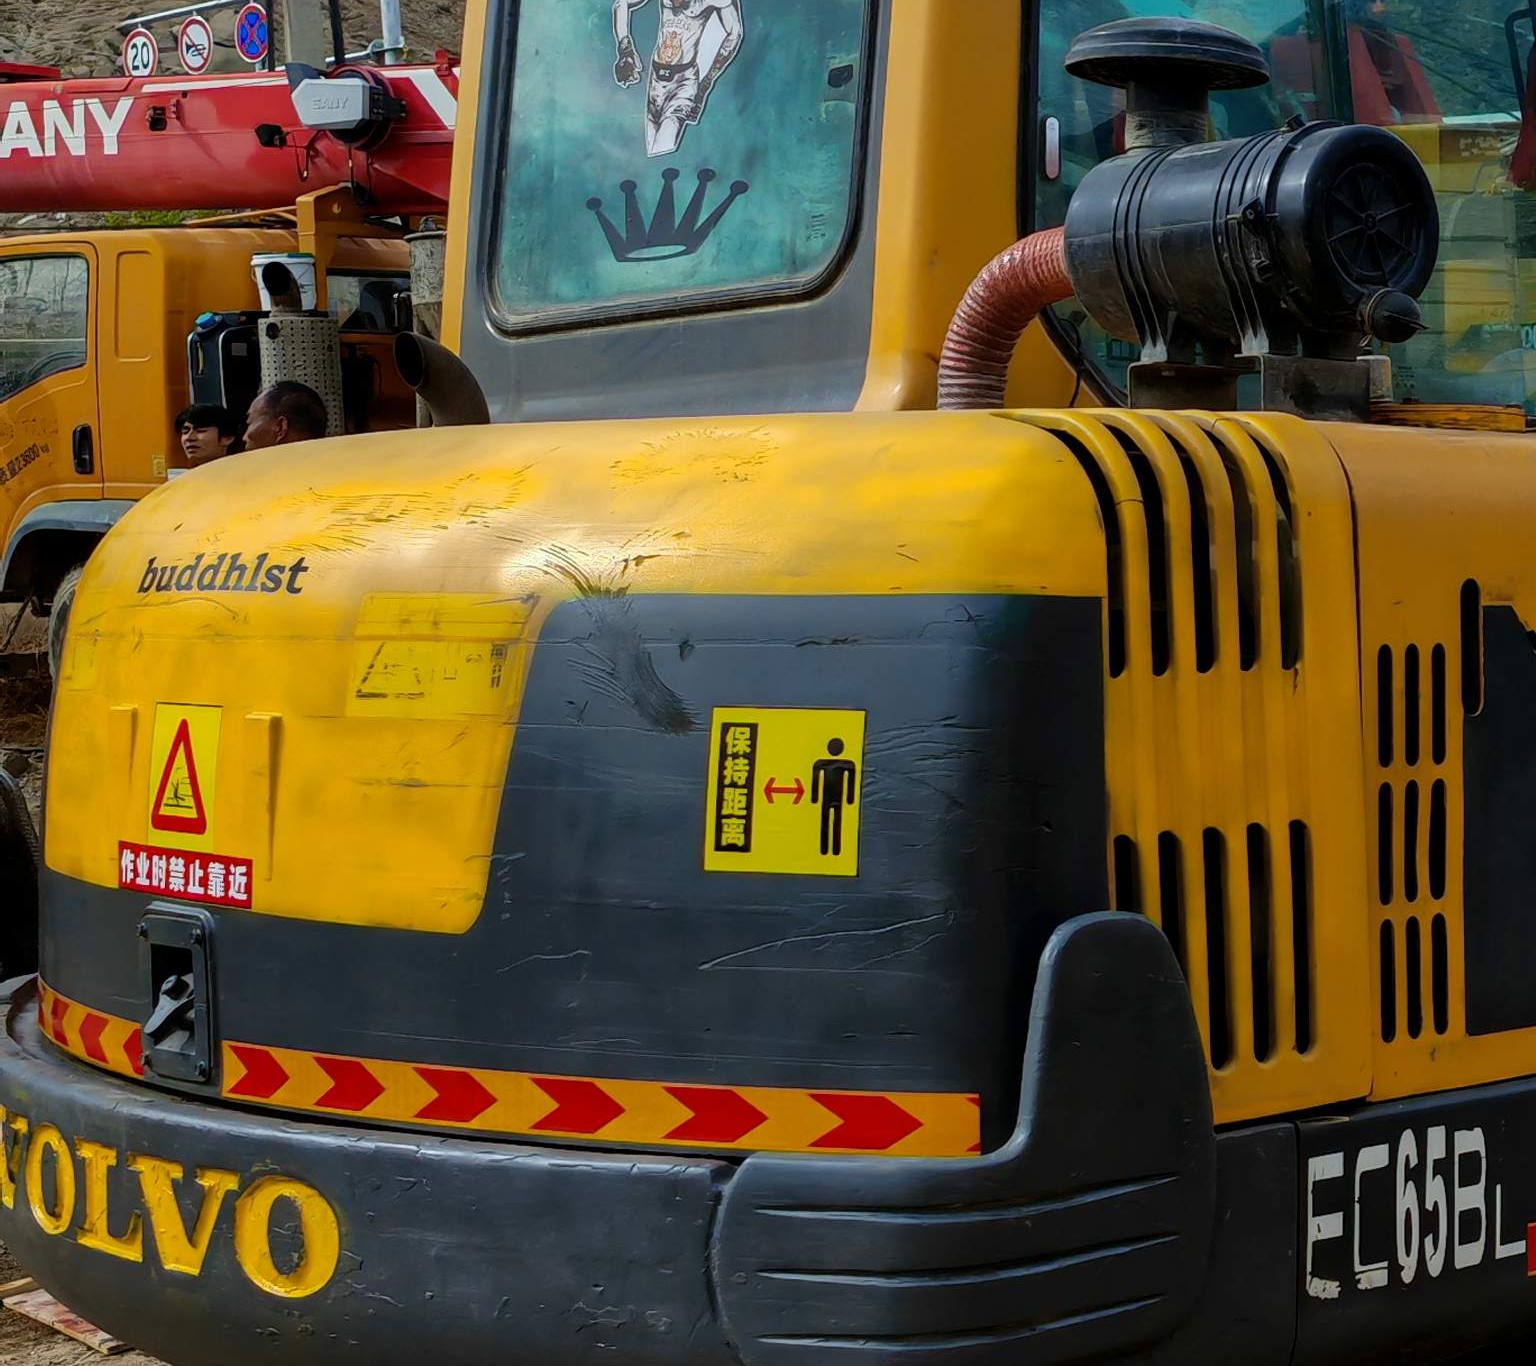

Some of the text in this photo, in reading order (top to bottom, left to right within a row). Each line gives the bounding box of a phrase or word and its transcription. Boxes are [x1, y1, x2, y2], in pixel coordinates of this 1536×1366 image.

[131, 42, 150, 71] 20
[721, 726, 752, 848] 保持距离
[121, 849, 248, 901] 作业时禁止靠近
[0, 1103, 341, 1299] VOLVO
